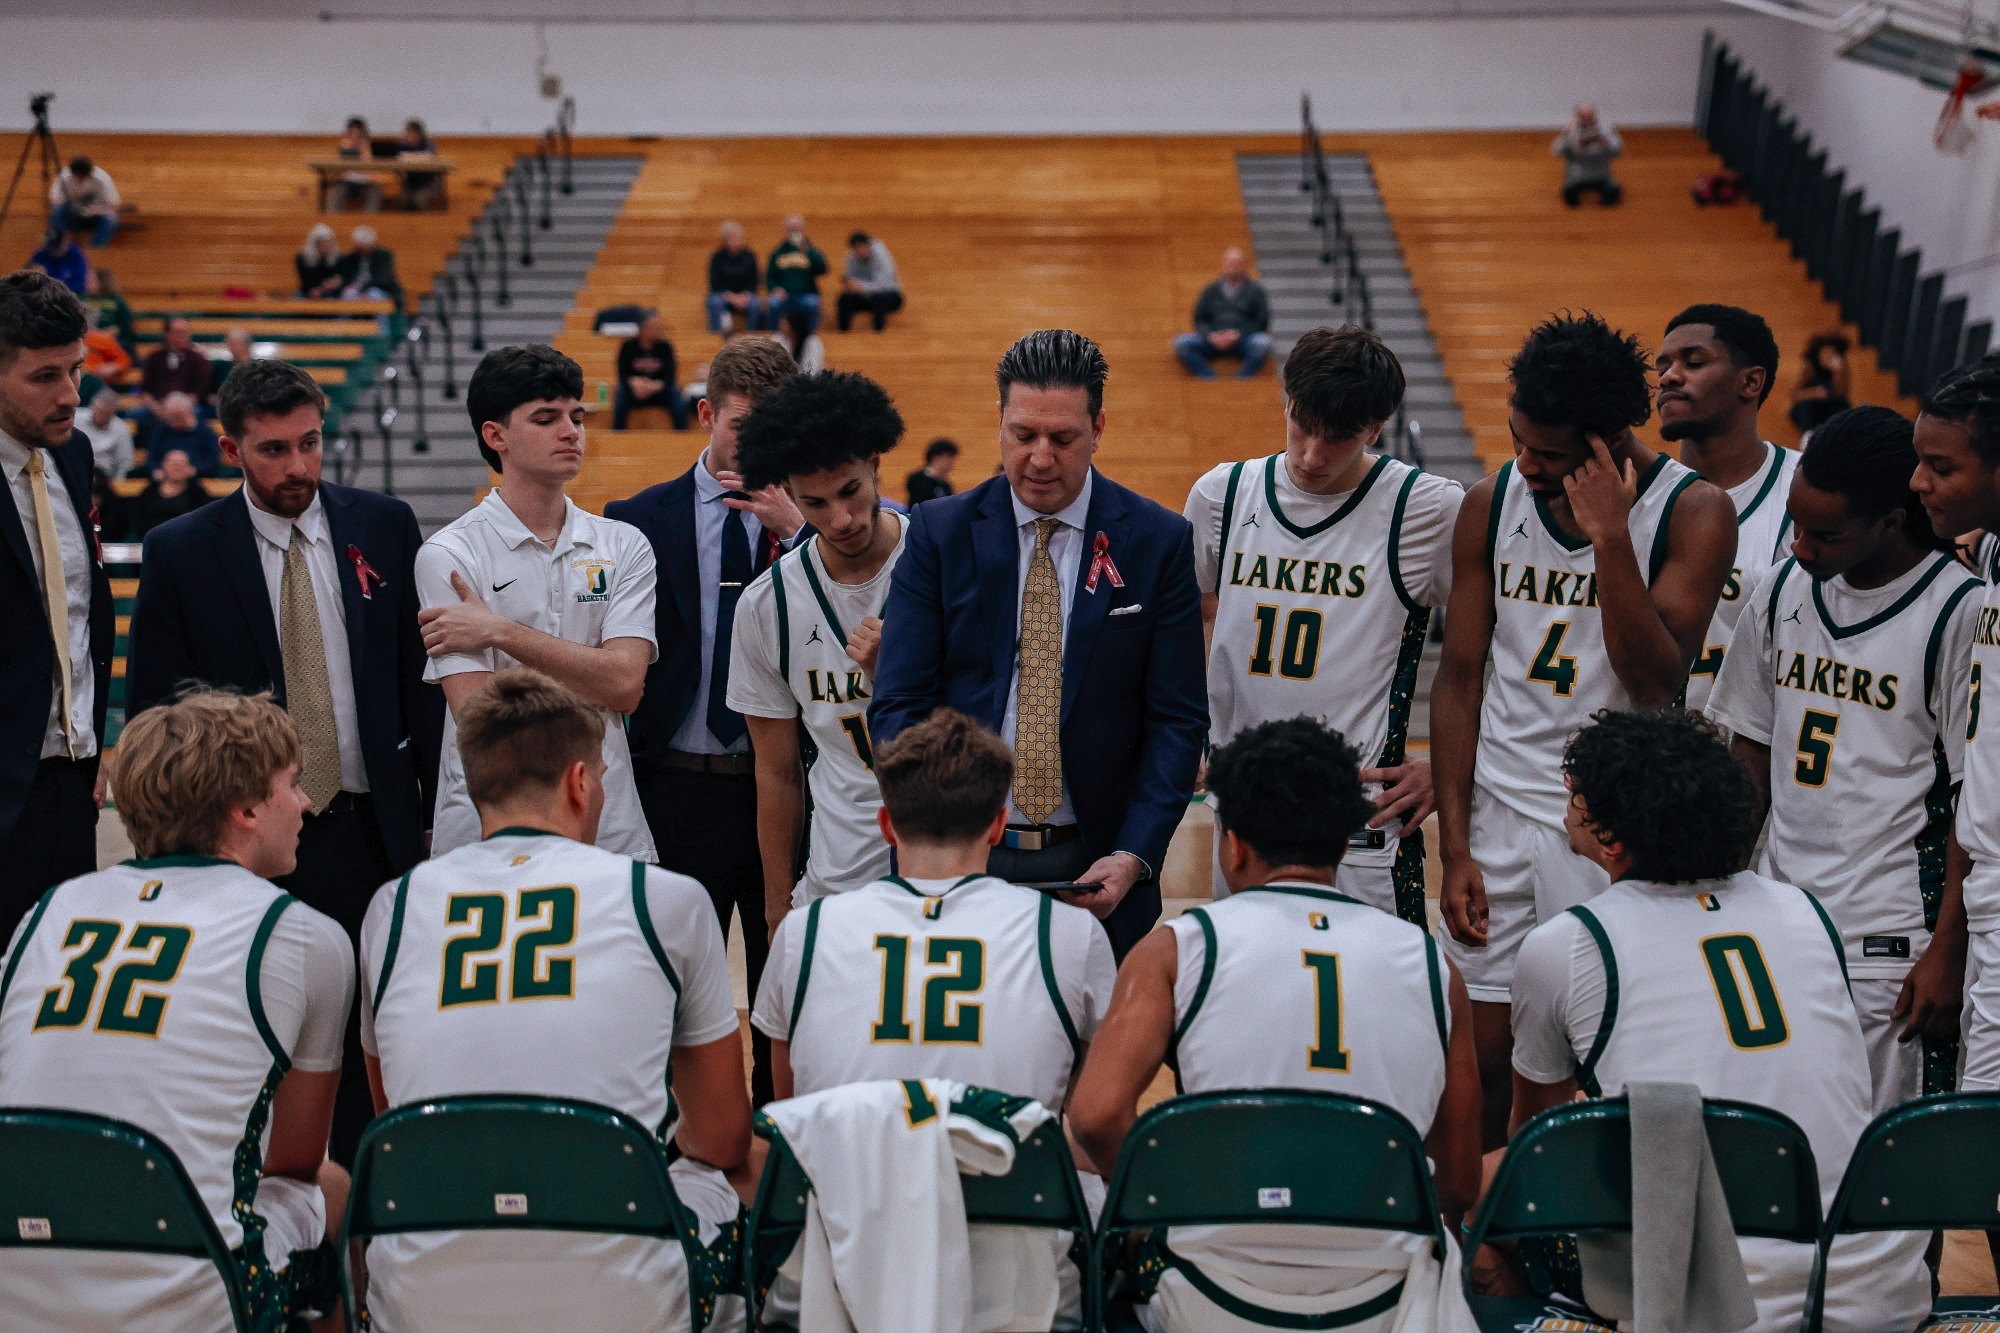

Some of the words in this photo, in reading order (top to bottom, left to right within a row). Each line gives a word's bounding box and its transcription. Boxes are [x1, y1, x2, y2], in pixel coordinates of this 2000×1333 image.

[1229, 551, 1368, 598] LAKERS
[1248, 602, 1325, 681] 10
[1527, 620, 1579, 698] 4
[1775, 649, 1899, 712] LAKERS
[806, 668, 873, 704] LAK
[1794, 707, 1840, 788] 5
[31, 918, 195, 1040] 32
[438, 883, 580, 1011] 22
[1896, 942, 1902, 951] L
[870, 932, 987, 1047] 12
[1301, 949, 1352, 1074] 1
[1698, 931, 1791, 1051] 0
